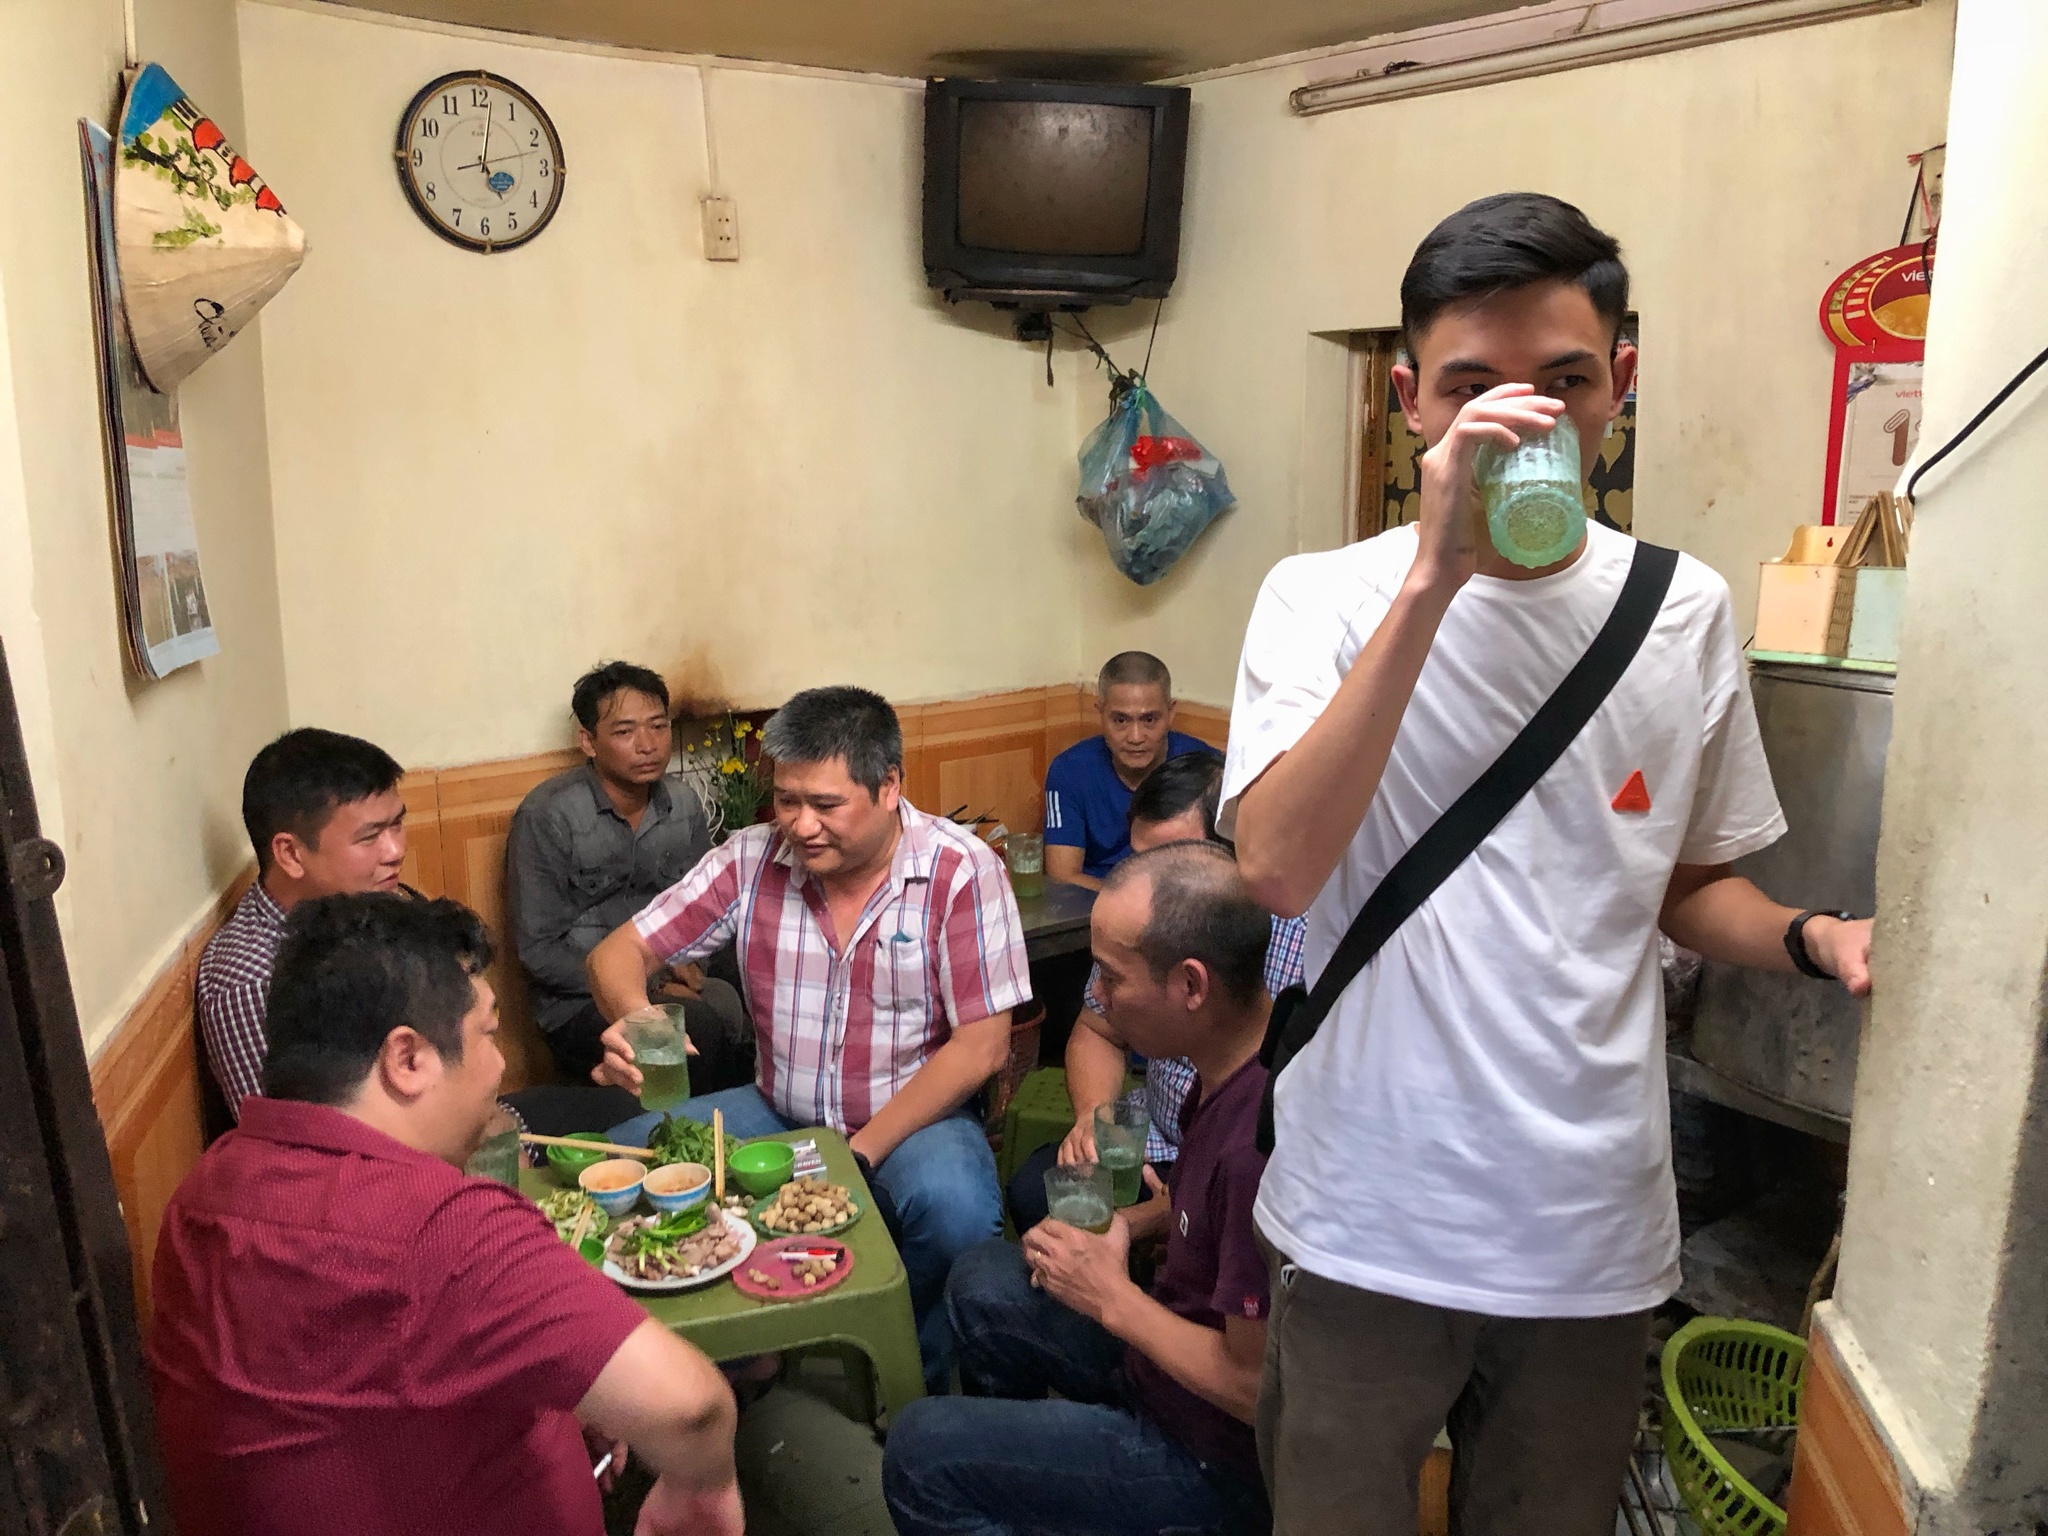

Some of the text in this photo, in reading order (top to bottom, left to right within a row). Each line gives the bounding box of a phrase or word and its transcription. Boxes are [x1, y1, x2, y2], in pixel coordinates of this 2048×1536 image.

[442, 95, 460, 116] 11
[471, 88, 489, 108] 12
[508, 102, 516, 122] 1
[421, 118, 439, 138] 10
[529, 128, 539, 147] 2
[413, 148, 423, 167] 9
[539, 159, 549, 178] 3
[426, 182, 436, 202] 8
[529, 190, 538, 208] 4
[452, 209, 462, 227] 7
[480, 217, 490, 236] 6
[508, 212, 518, 231] 5
[1883, 409, 1922, 467] 1
